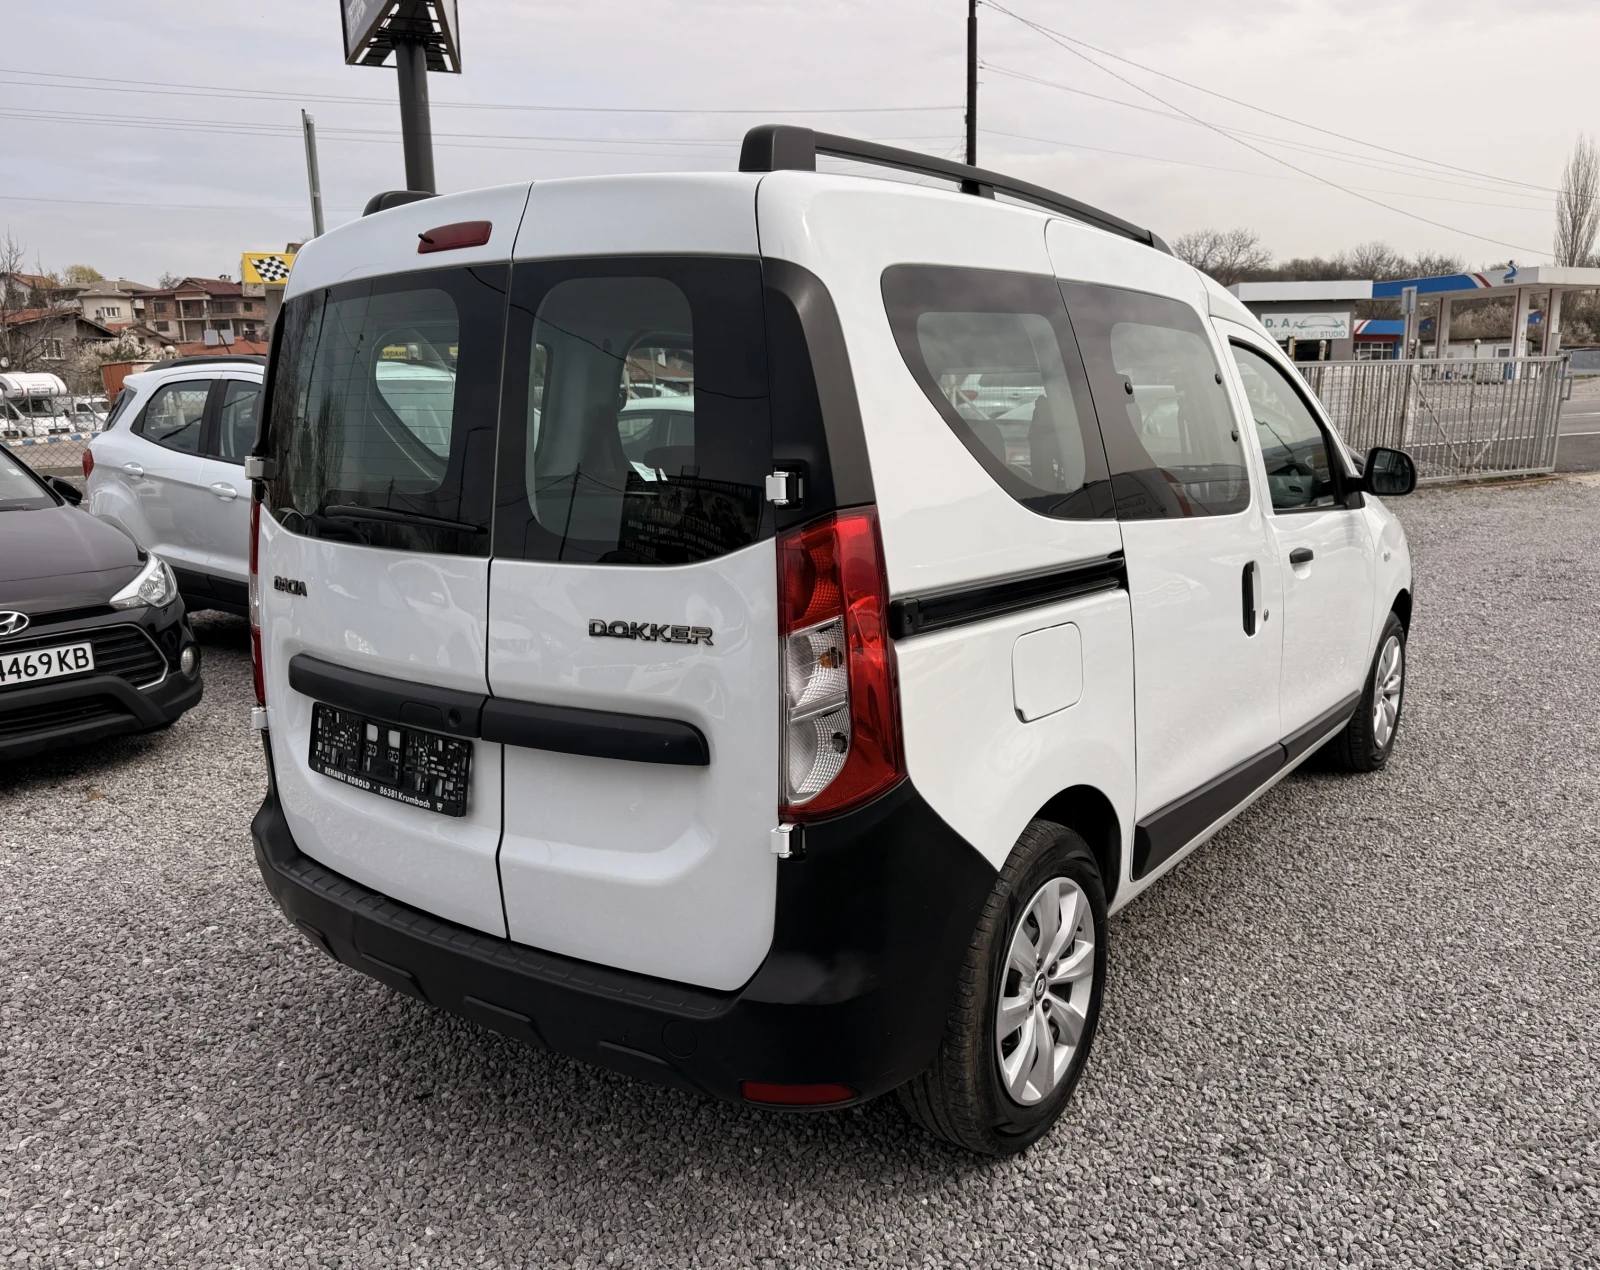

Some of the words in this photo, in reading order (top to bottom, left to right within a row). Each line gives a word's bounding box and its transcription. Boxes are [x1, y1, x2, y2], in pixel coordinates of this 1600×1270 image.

[1265, 318, 1277, 328] D.
[1281, 318, 1290, 328] A
[1271, 331, 1319, 339] RDETAILING
[1320, 330, 1346, 338] STUDIO
[274, 575, 308, 597] DACIA
[588, 618, 715, 646] DOKKER
[56, 646, 90, 673] KB
[324, 766, 346, 781] RENAULT
[347, 775, 370, 789] KOBOLD
[379, 786, 398, 799] 86381
[398, 791, 431, 809] Krumbach
